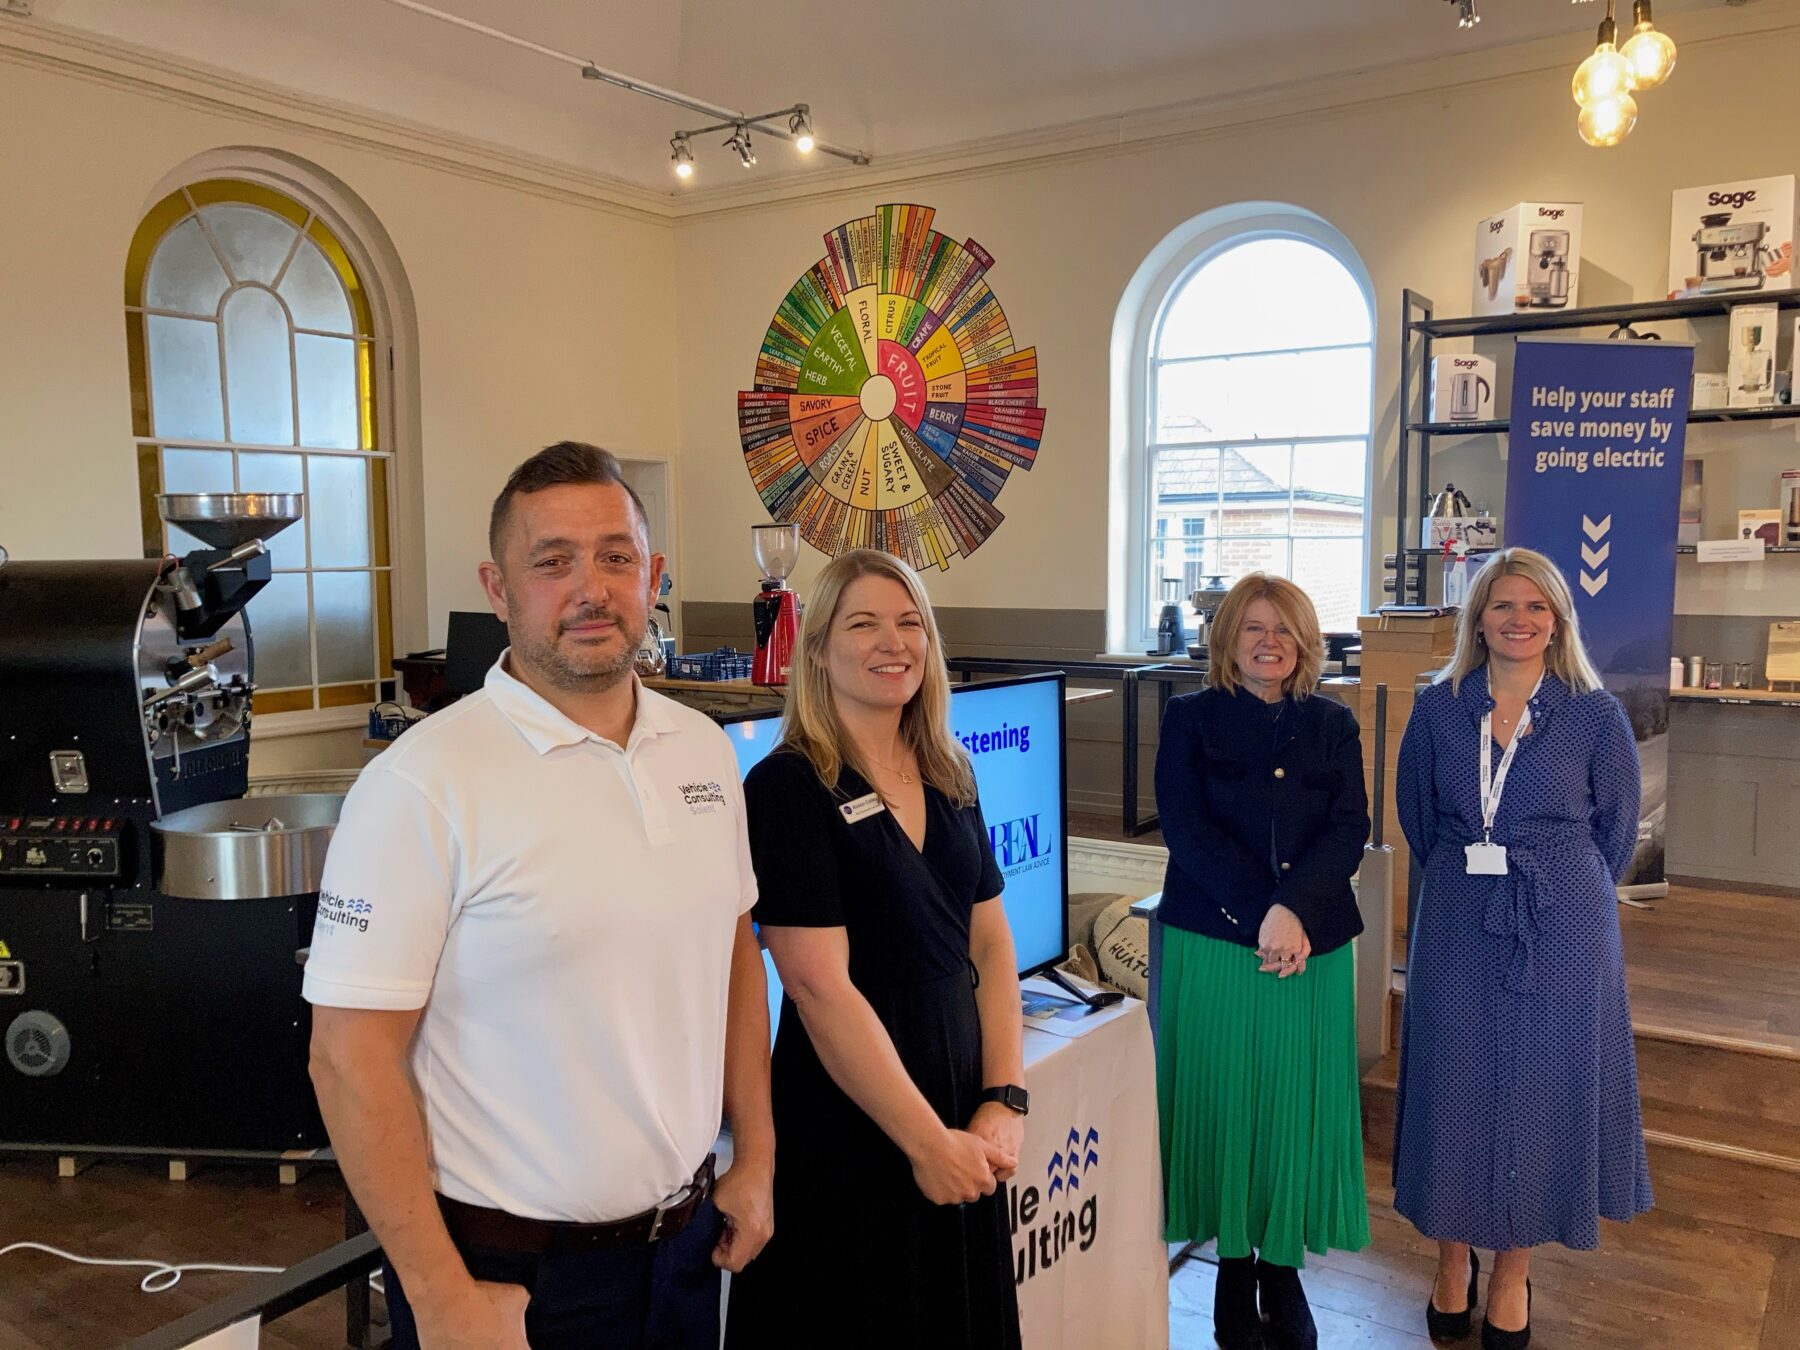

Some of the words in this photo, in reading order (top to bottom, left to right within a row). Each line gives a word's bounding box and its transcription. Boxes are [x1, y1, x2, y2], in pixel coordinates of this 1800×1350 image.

[1707, 190, 1756, 209] Sage
[1538, 207, 1565, 220] Sage
[1489, 219, 1504, 234] Sage
[972, 244, 989, 262] WINE
[858, 300, 872, 344] FLORAL
[886, 300, 896, 334] CITRUS
[904, 315, 920, 342] MELON
[911, 321, 933, 349] GRAPE
[830, 324, 858, 372] VEGETAL
[922, 343, 947, 363] TROPICAL
[813, 346, 845, 376] EARTHY
[926, 355, 942, 369] FRUIT
[987, 359, 1005, 368] PEACH
[988, 364, 1017, 375] NECTARINE
[1454, 358, 1479, 369] Sage
[805, 369, 828, 386] HERB
[887, 353, 917, 413] FRUIT
[989, 374, 1012, 382] APRICOT
[800, 399, 832, 412] SAVORY
[1532, 385, 1576, 413] Help
[1580, 390, 1626, 413] your
[1630, 388, 1675, 409] staff
[929, 408, 959, 425] BERRY
[994, 407, 1026, 416] CRANBERRY
[805, 416, 840, 446] SPICE
[989, 429, 1019, 442] BLUEBERRY
[1530, 420, 1575, 437] save
[1579, 421, 1646, 443] money
[1650, 417, 1672, 443] by
[819, 441, 841, 471] ROAST
[900, 427, 935, 473] CHOCOLATE
[1535, 446, 1588, 473] going
[1592, 447, 1665, 467] electric
[831, 456, 850, 484] GRAIN
[846, 450, 854, 458] &
[841, 459, 858, 490] CEREAL
[881, 446, 895, 493] SUGARY
[889, 441, 908, 481] SWEET
[902, 484, 911, 493] &
[860, 468, 871, 496] NUT
[955, 722, 1030, 753] stening
[678, 782, 708, 794] Vehicle
[684, 792, 726, 806] Consulting
[1002, 867, 1021, 879] OYMENT
[1022, 863, 1032, 873] LAW
[1033, 857, 1050, 869] ADVICE
[320, 889, 345, 909] ehicle
